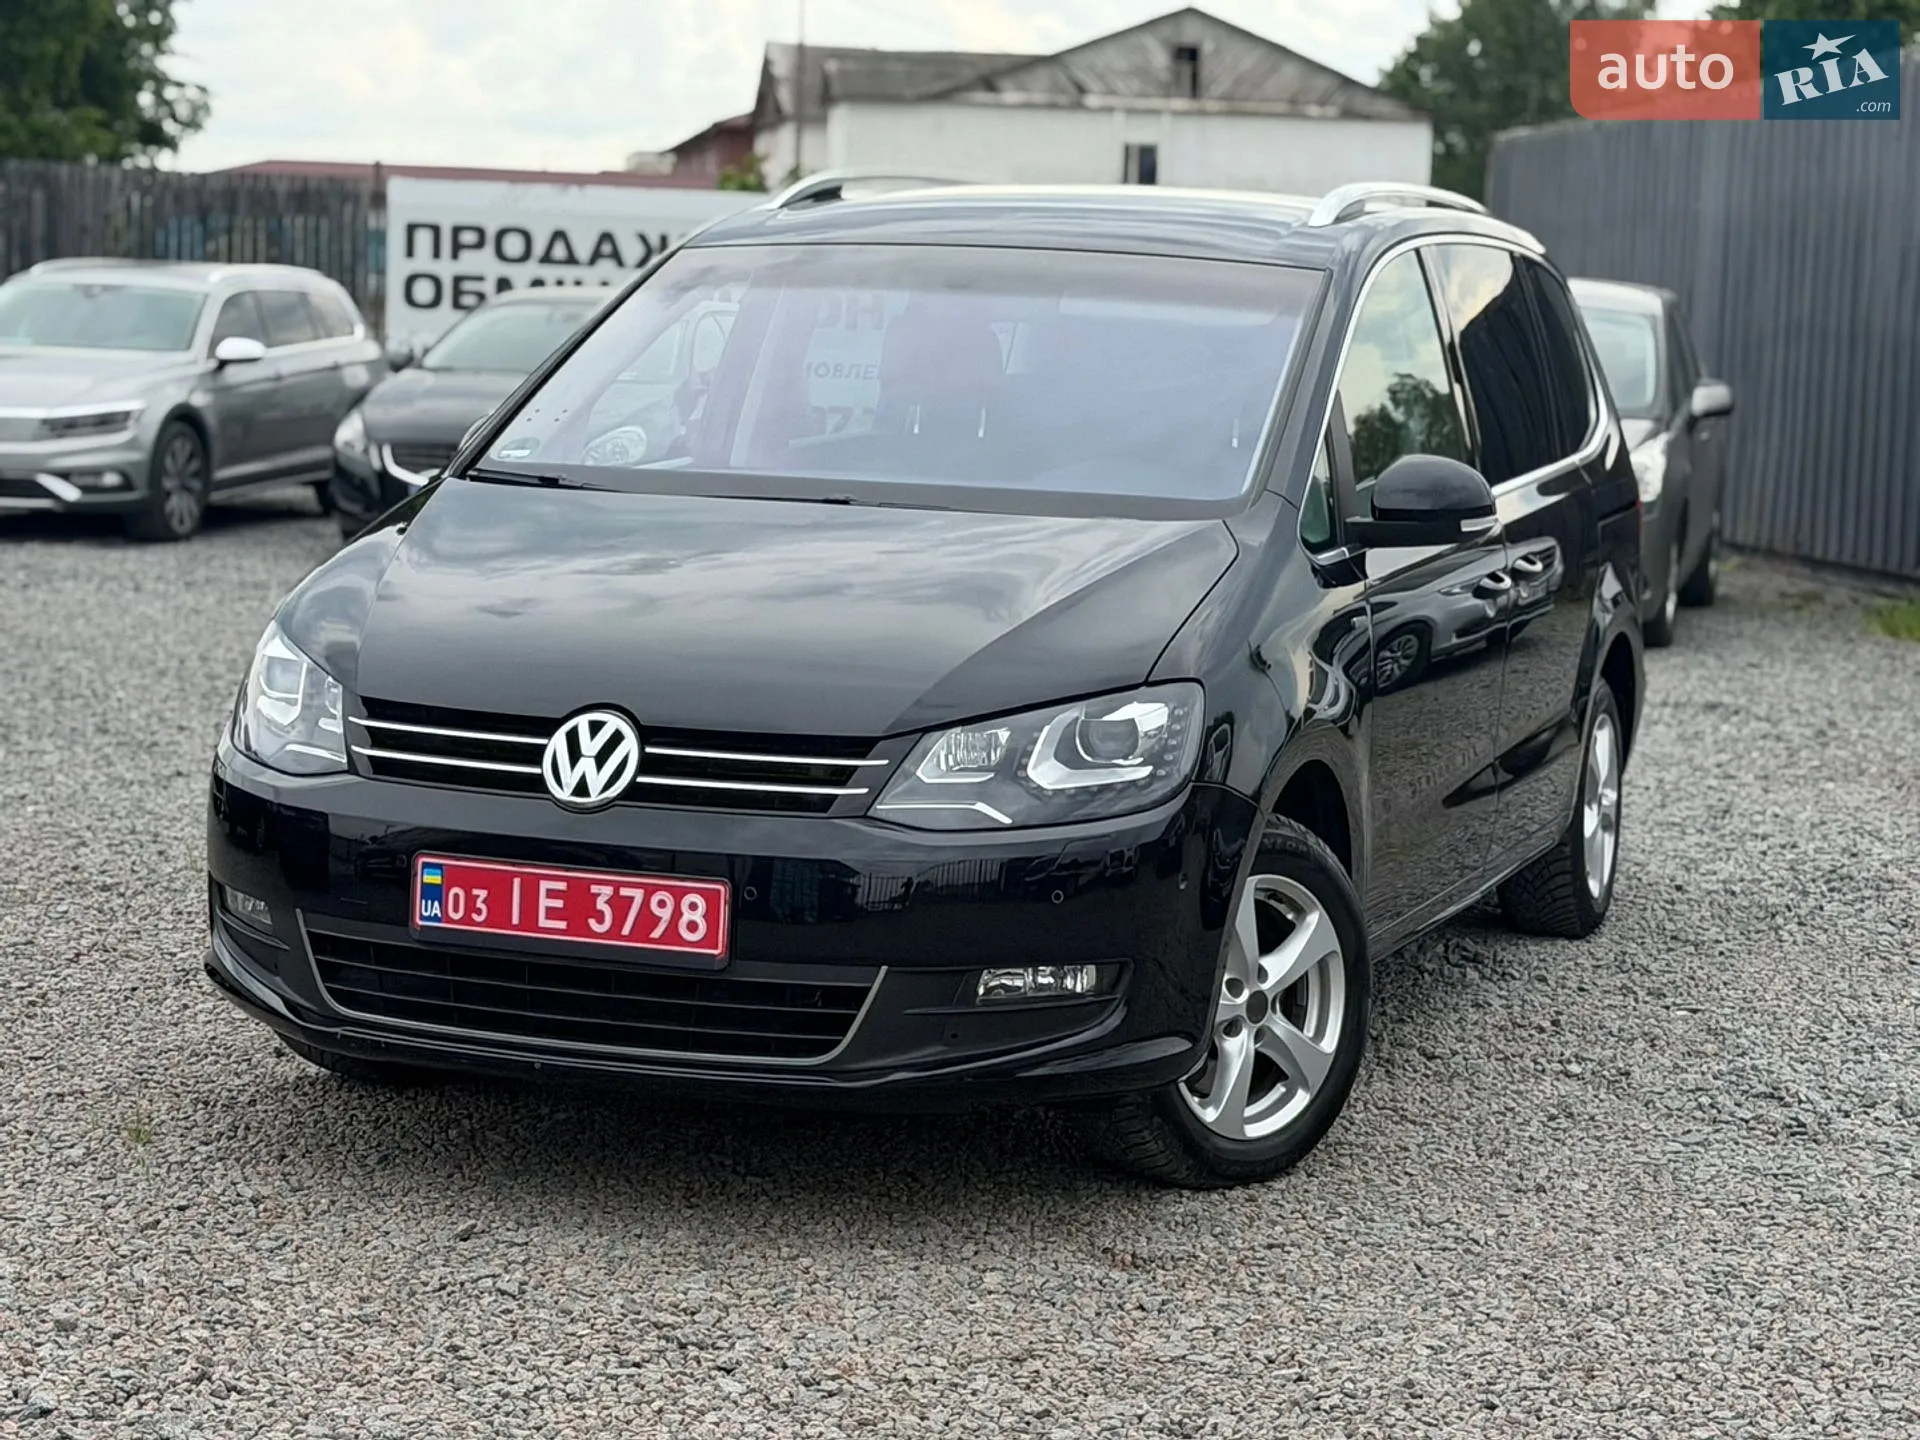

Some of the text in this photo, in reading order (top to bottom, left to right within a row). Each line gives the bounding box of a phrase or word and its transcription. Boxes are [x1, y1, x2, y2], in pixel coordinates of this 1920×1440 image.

[421, 899, 442, 918] UA
[447, 886, 489, 922] 03
[587, 884, 708, 943] 3798
